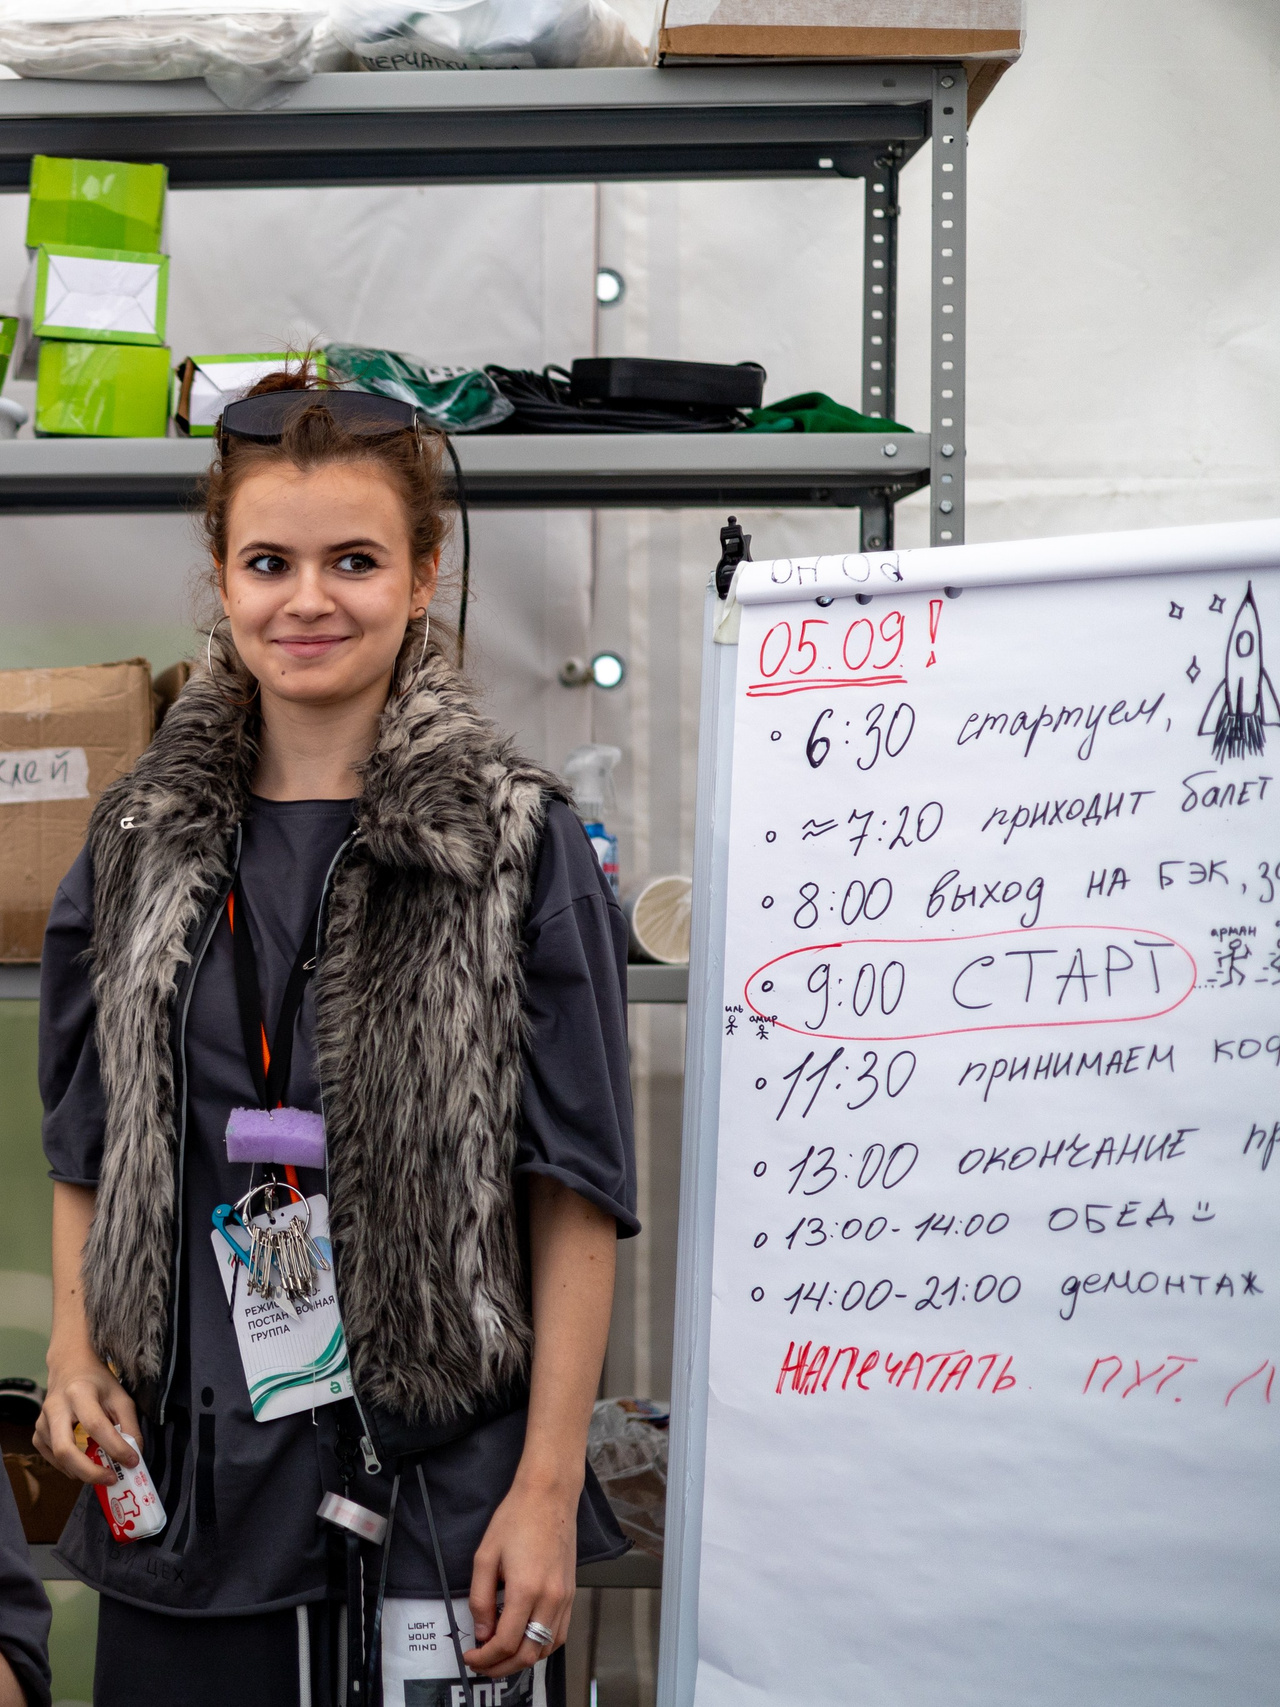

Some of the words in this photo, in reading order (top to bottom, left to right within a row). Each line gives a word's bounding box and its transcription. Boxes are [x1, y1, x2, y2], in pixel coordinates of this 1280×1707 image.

[806, 703, 915, 770] 6:30
[793, 878, 892, 929] 8:00
[805, 961, 905, 1030] 9:00
[953, 939, 1175, 1010] СТАРТ
[775, 1046, 917, 1122] 11:30
[788, 1142, 919, 1196] 13:00
[248, 1295, 336, 1330] ПОСТАНВОНАЯ
[251, 1324, 291, 1342] ГРУППА
[407, 1621, 436, 1630] LIGHT
[408, 1633, 436, 1641] YOUR
[408, 1643, 437, 1652] MIND
